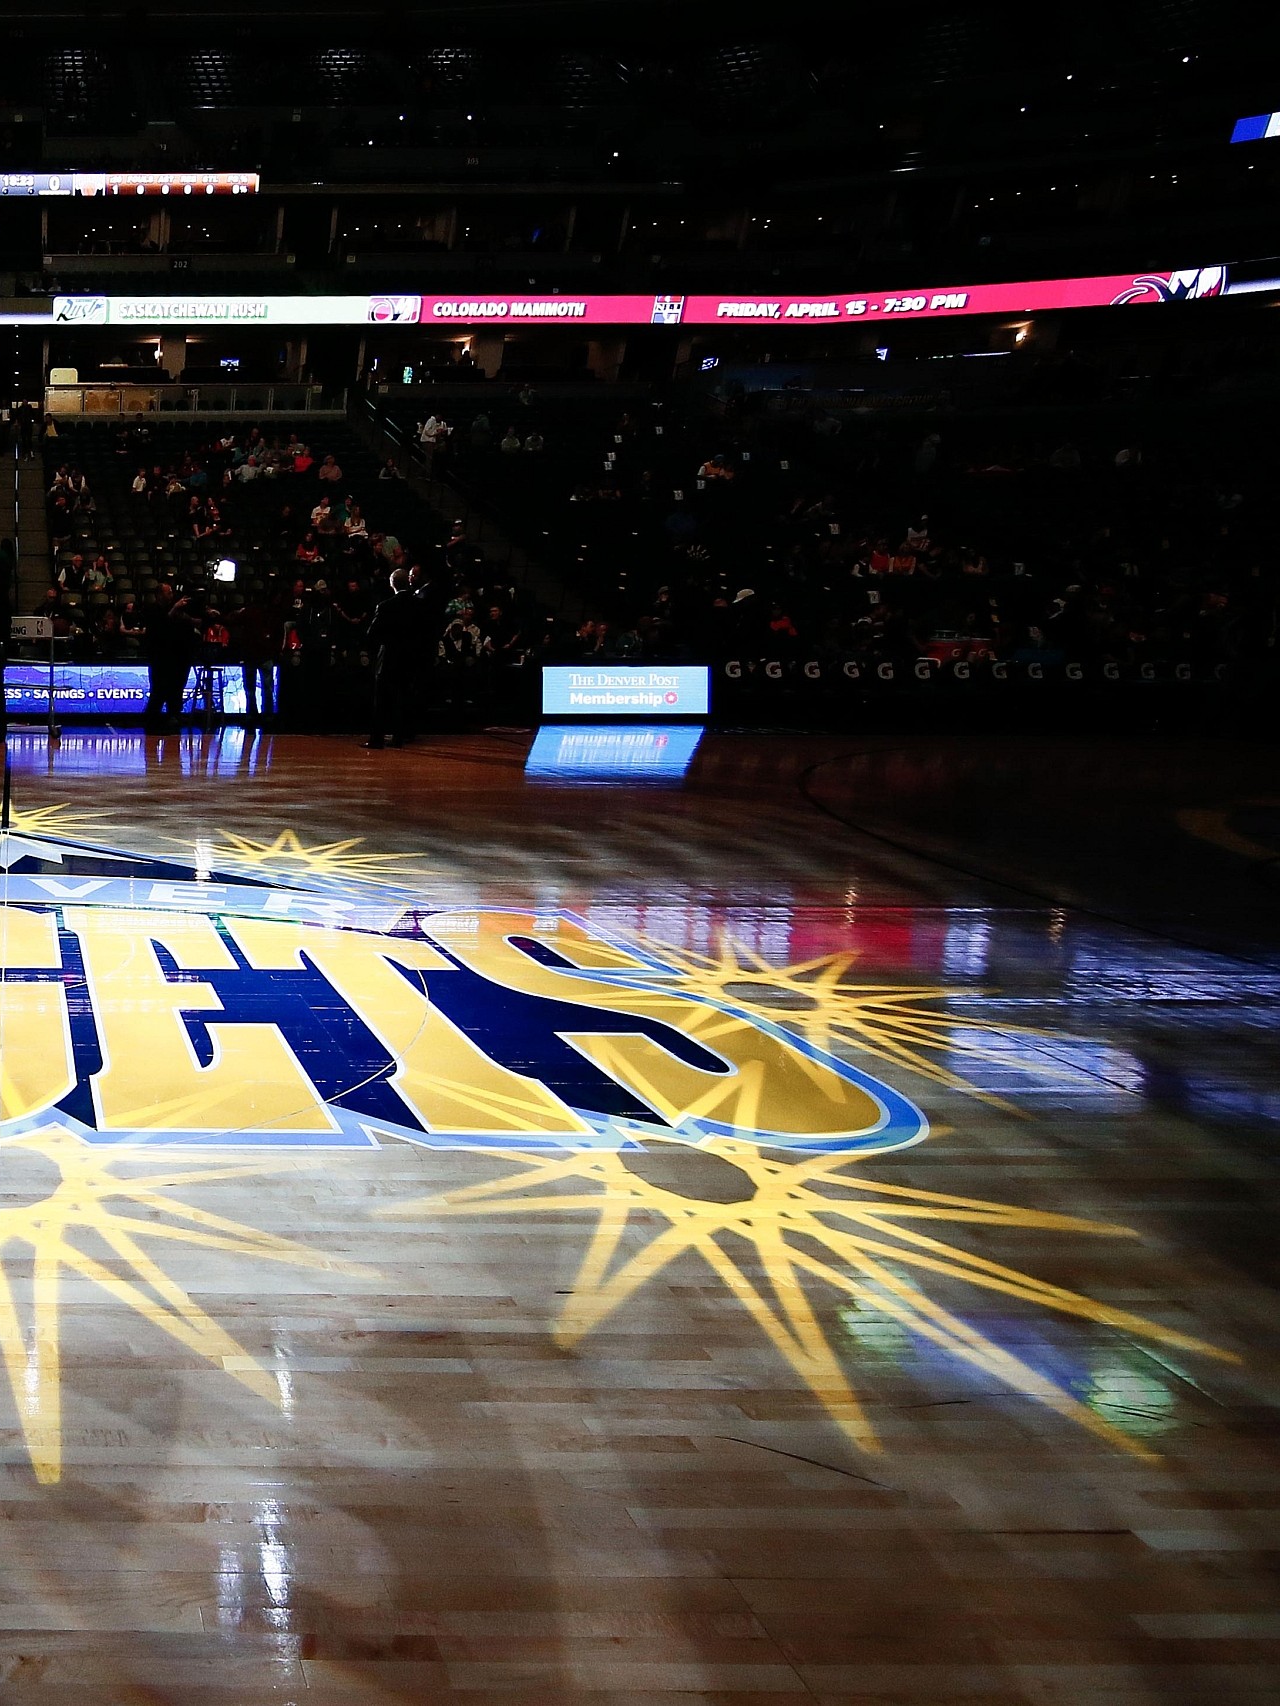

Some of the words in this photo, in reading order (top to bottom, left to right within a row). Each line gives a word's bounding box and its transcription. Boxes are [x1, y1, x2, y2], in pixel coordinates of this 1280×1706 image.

[173, 260, 188, 269] 202
[119, 303, 228, 319] SASKATCHEWAN
[229, 303, 268, 319] RUSH
[432, 302, 508, 317] COLORADO
[509, 302, 586, 317] MAMMOTH
[717, 303, 781, 319] FRIDAY,
[785, 303, 840, 317] APRIL
[845, 301, 868, 316] 15
[883, 298, 922, 313] 7:30
[929, 293, 968, 309] PM
[725, 661, 741, 678] G
[766, 661, 782, 678] G
[804, 661, 820, 678] G
[843, 661, 859, 678] G
[877, 662, 893, 679] G
[915, 662, 930, 679] G
[954, 662, 970, 679] G
[992, 662, 1008, 679] G
[1028, 663, 1043, 679] G
[1066, 663, 1083, 679] G
[97, 689, 143, 699] EVENTS
[570, 693, 663, 707] Membership
